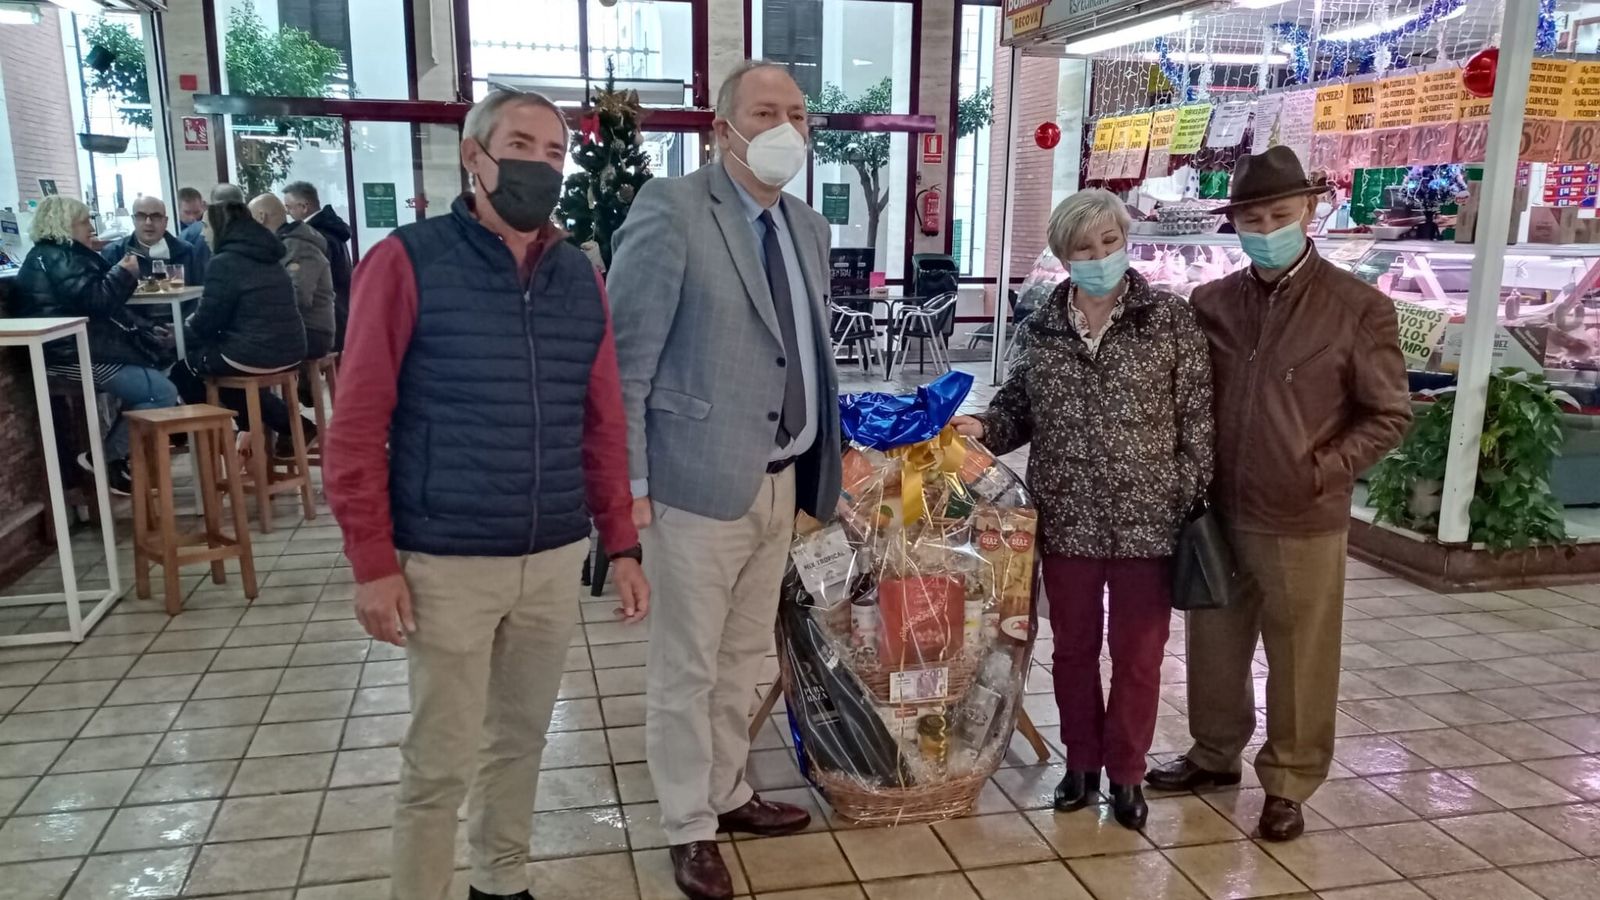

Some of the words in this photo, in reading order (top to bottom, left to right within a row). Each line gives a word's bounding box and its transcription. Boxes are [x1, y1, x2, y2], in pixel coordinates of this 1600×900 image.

[1014, 11, 1039, 29] RECOVA
[1352, 87, 1375, 104] BERZA
[1323, 105, 1332, 116] DE
[1428, 322, 1437, 333] Y
